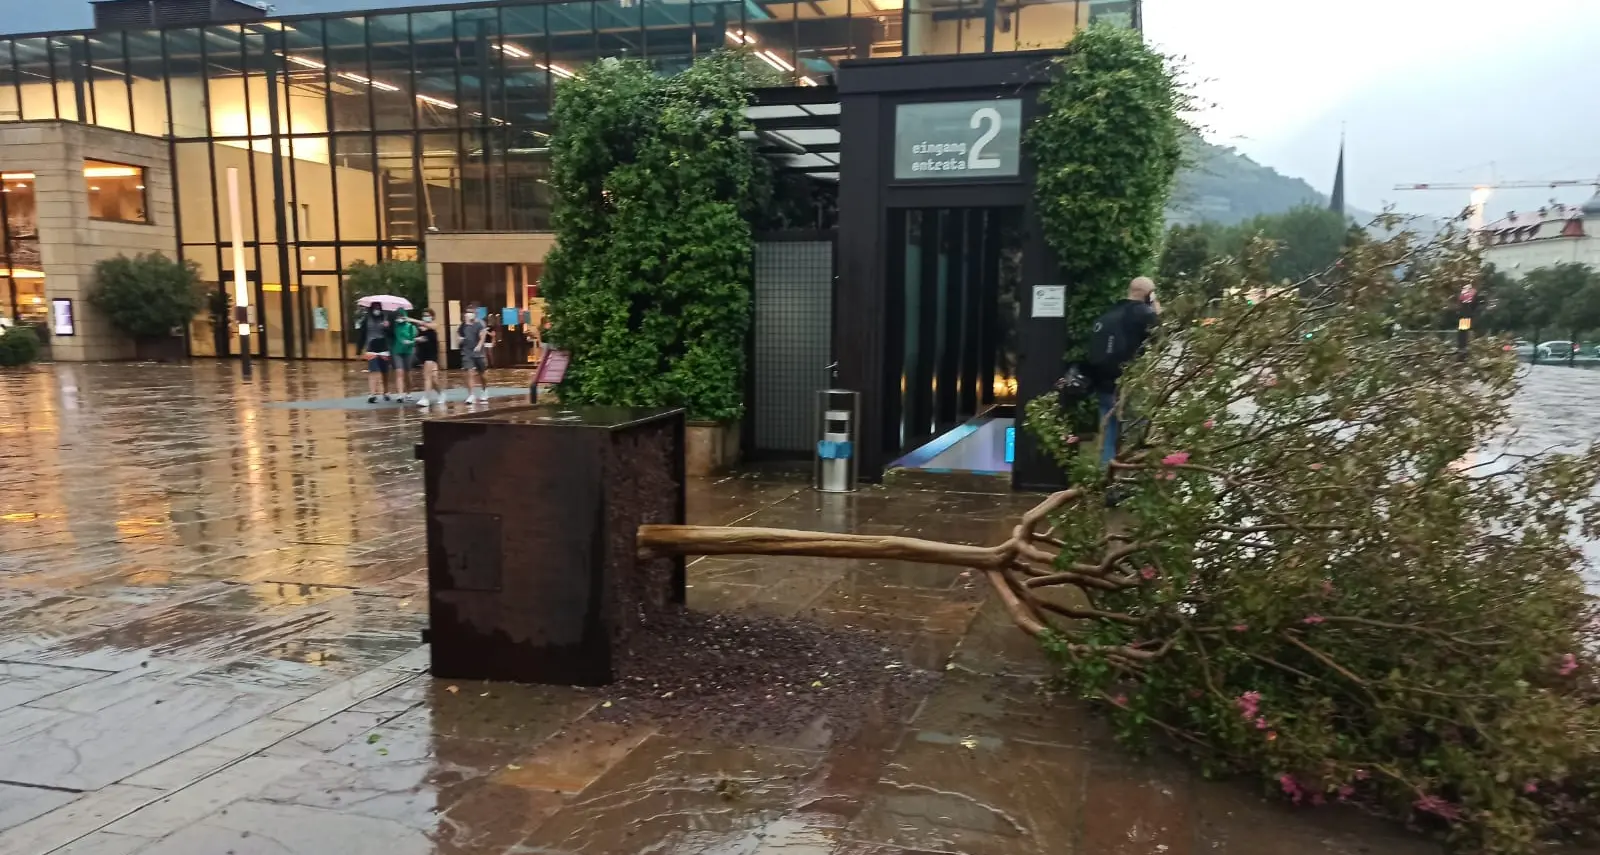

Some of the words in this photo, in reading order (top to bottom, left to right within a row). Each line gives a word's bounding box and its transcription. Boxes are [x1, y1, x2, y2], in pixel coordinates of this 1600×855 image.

[967, 107, 1002, 169] 2
[912, 141, 967, 156] eingang
[911, 158, 966, 171] entrata
